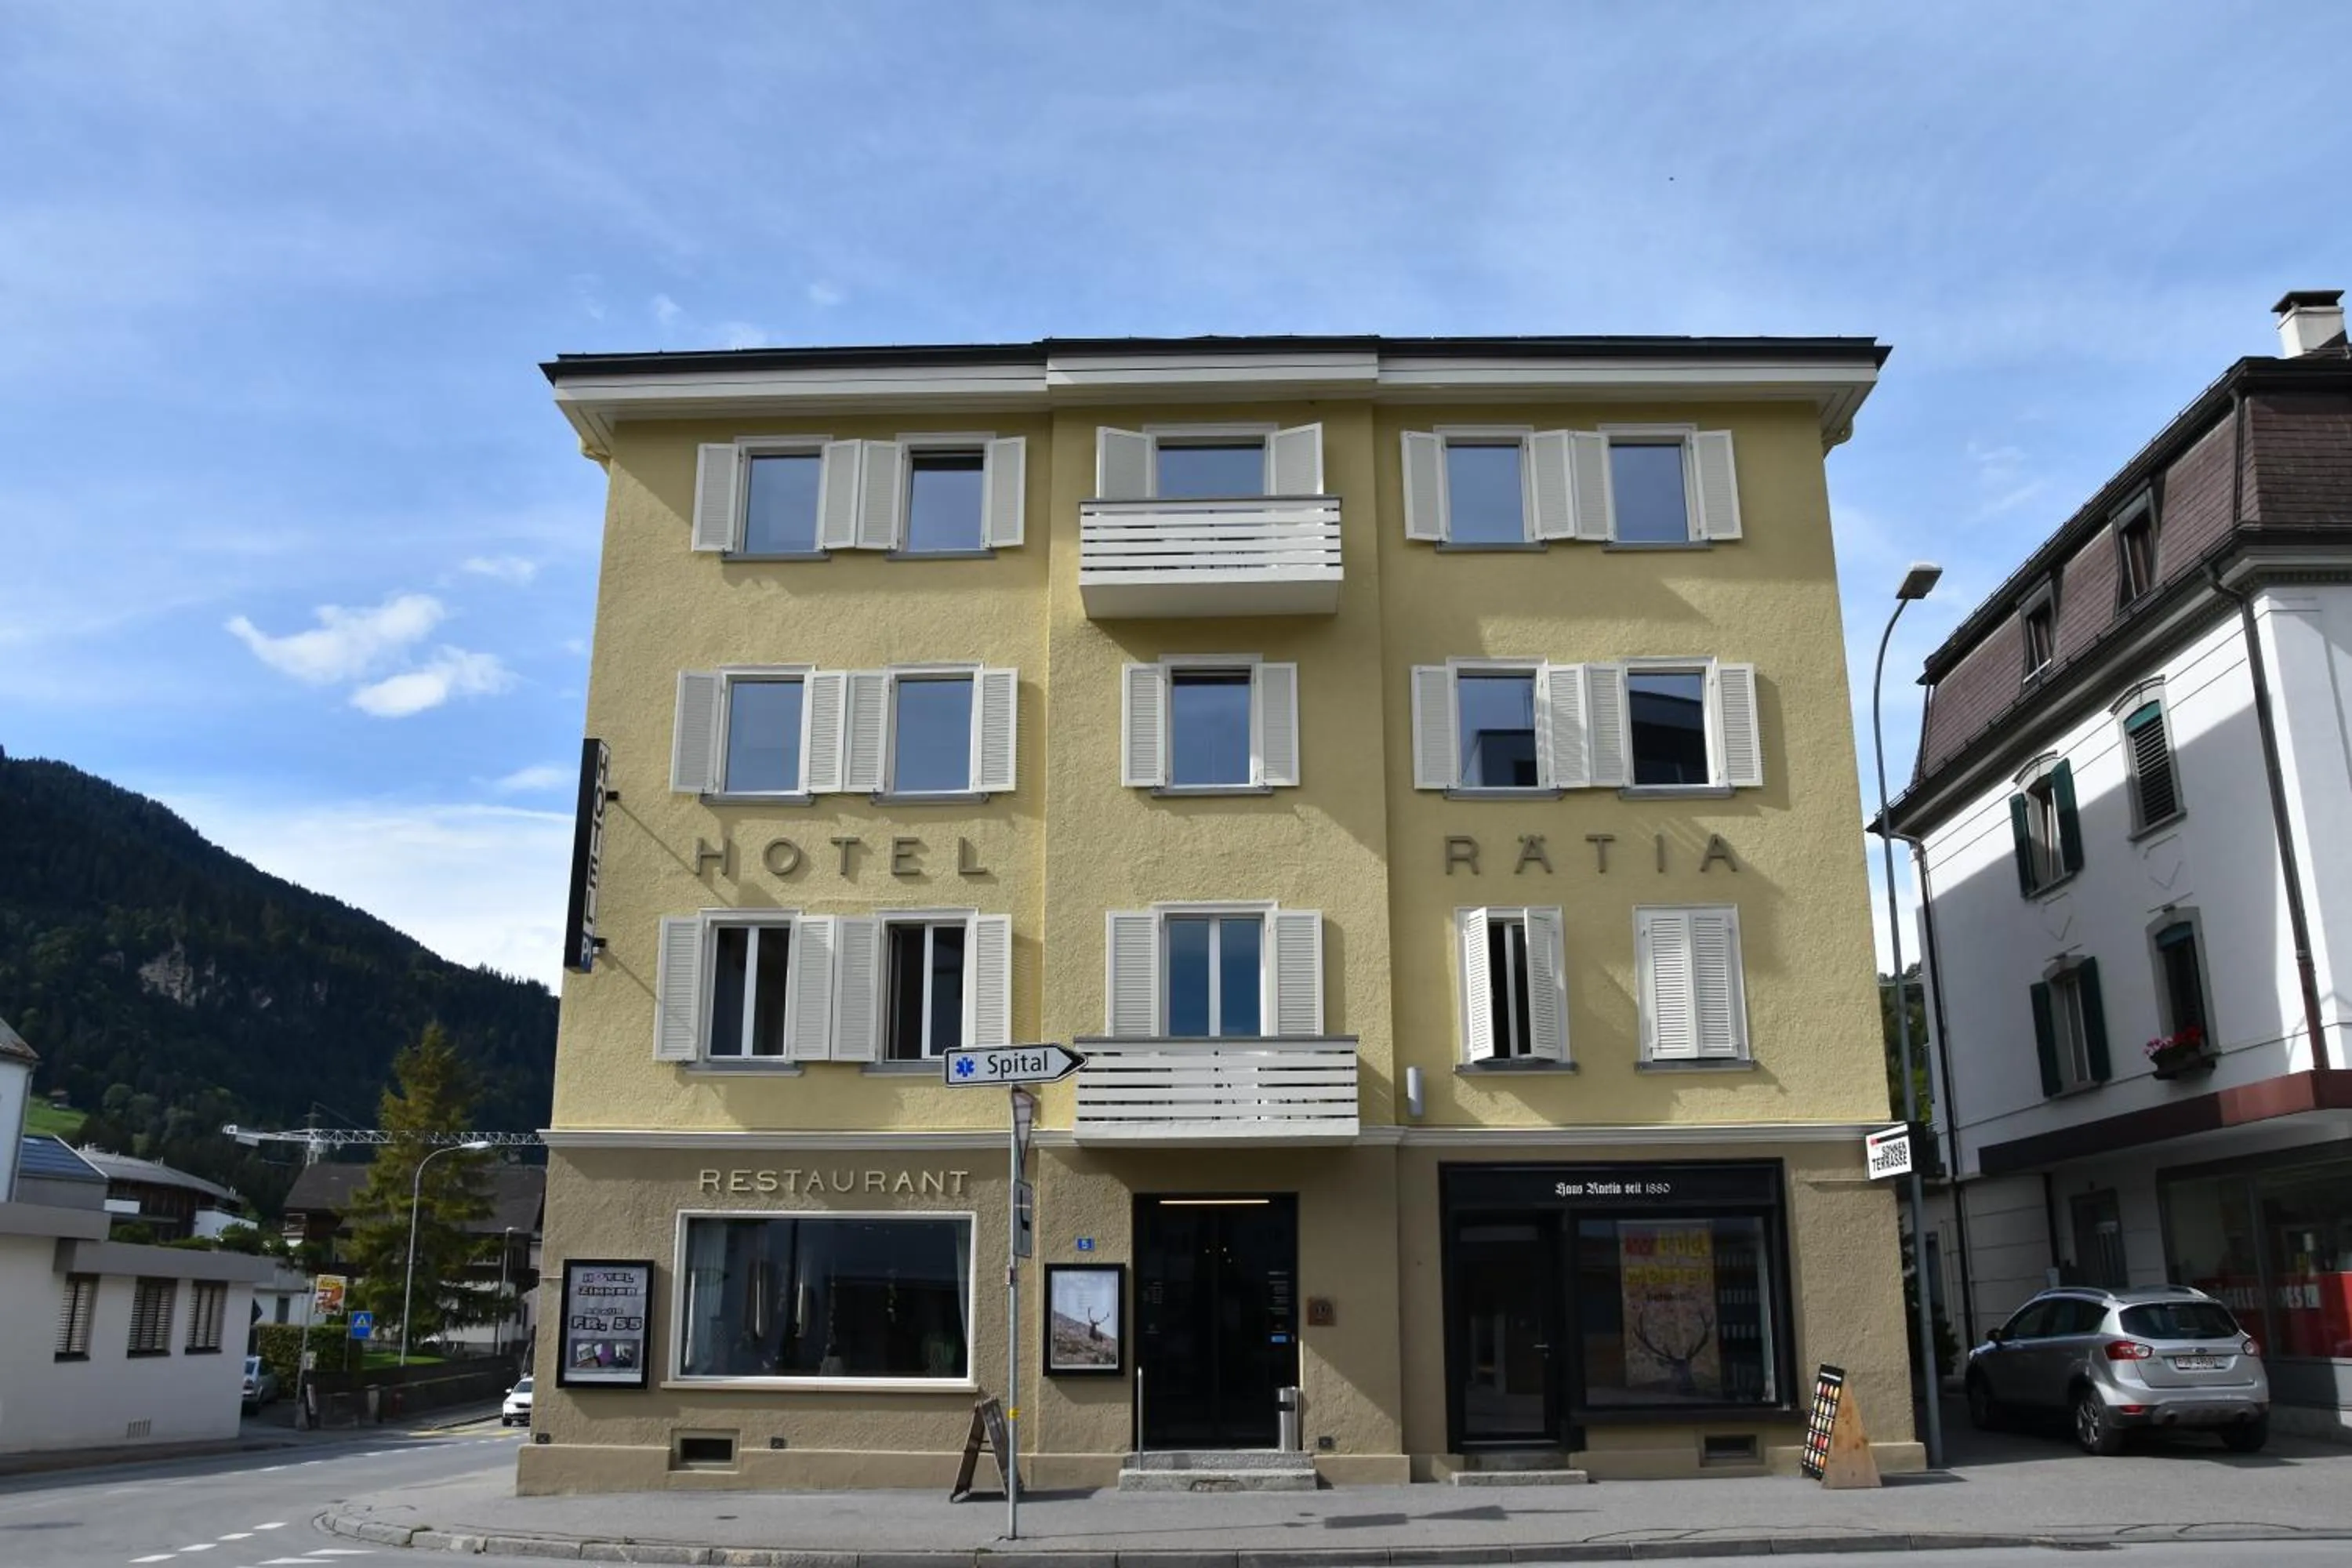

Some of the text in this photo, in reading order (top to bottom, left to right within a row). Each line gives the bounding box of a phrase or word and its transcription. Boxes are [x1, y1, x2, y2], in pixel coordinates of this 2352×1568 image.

[586, 749, 608, 924] HOTEL
[695, 833, 1739, 877] HOTEL RÄTIA
[987, 1050, 1048, 1080] Spital
[1882, 1141, 1907, 1155] SONNEN
[1871, 1152, 1907, 1172] TERRASSE
[699, 1168, 969, 1192] RESTAURANT
[1624, 1181, 1642, 1195] seit
[582, 1272, 634, 1283] HOTEL
[577, 1286, 637, 1297] ZIMMER
[613, 1316, 644, 1330] 55
